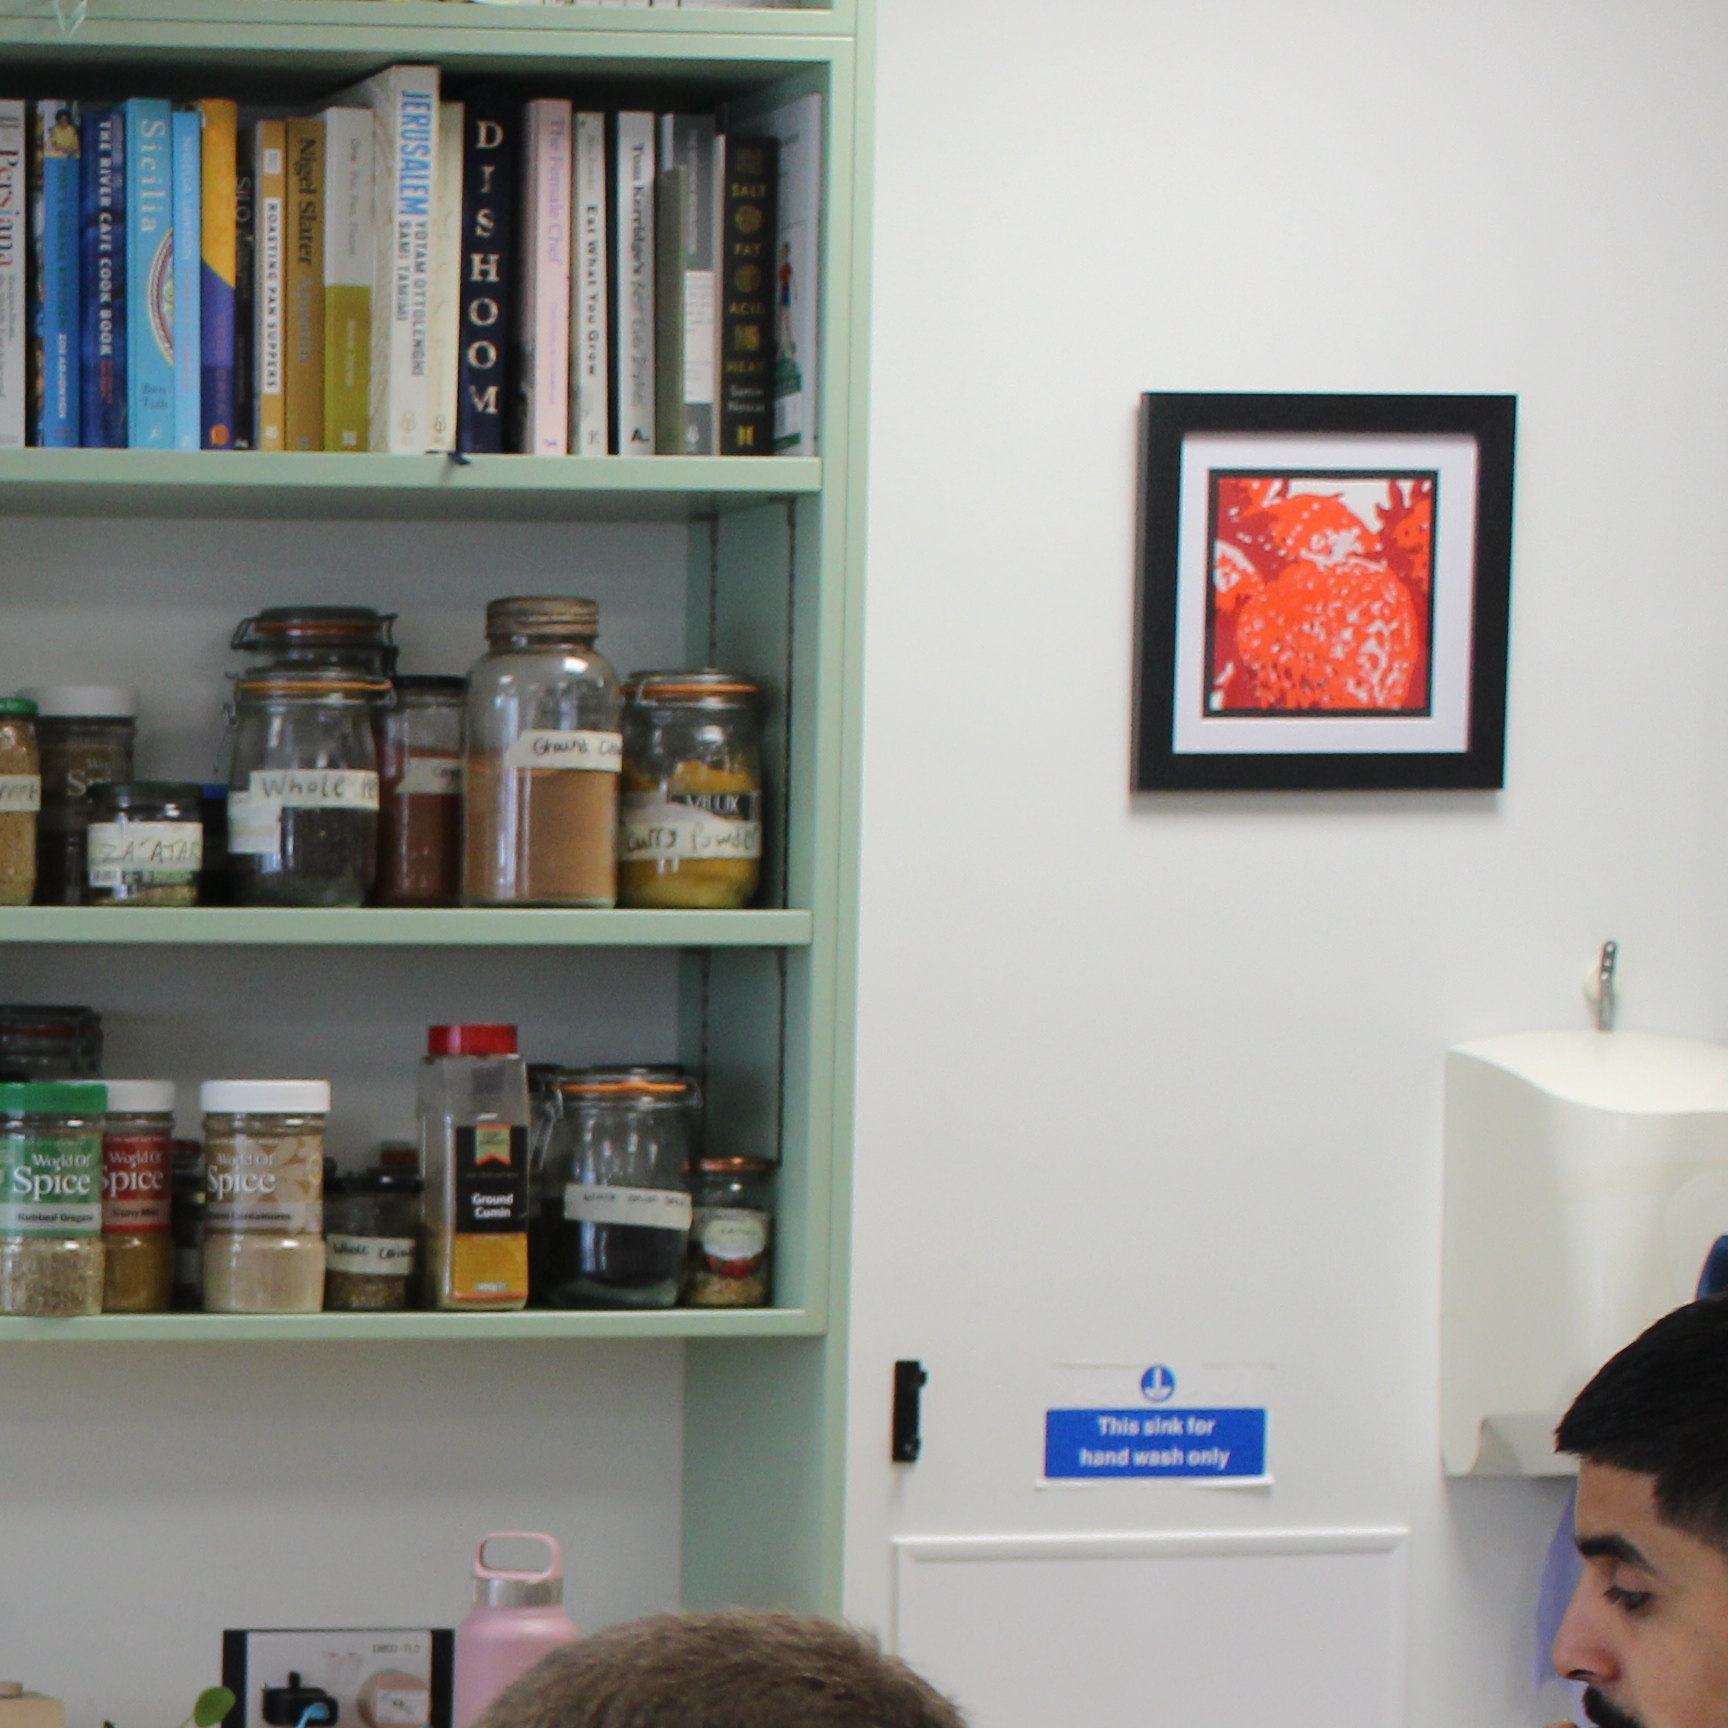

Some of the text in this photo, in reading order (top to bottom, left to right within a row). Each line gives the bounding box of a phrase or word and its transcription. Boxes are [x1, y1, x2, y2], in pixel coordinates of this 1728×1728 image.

[99, 120, 112, 151] THE
[399, 89, 433, 215] JERUSALEM
[140, 118, 167, 232] Sicilia
[295, 138, 317, 194] Nigel
[632, 142, 645, 181] Tom
[99, 157, 112, 207] RIVER
[548, 118, 565, 267] The Female Chef
[731, 181, 768, 199] SALT
[298, 200, 316, 267] Slater
[587, 205, 599, 234] Eat
[399, 220, 411, 260] SAMI
[733, 241, 762, 256] FAT
[99, 258, 111, 302] COOK
[467, 120, 504, 415] DISHOOM
[587, 240, 599, 286] What
[266, 202, 279, 389] ROASTING PAN SUPPERS
[412, 220, 427, 376] YOTAM OTTOLENGHI
[587, 293, 599, 325] You
[98, 309, 111, 356] BOOK
[587, 330, 599, 376] Grow
[262, 775, 344, 799] Whole
[32, 1154, 92, 1172] World Of
[109, 1151, 162, 1168] World Of
[217, 1152, 276, 1171] World Of
[12, 1167, 91, 1202] Spice
[207, 1166, 276, 1202] Spice
[472, 1192, 514, 1206] Ground
[17, 1212, 59, 1222] Rubbed
[474, 1206, 511, 1219] Cumin
[1097, 1416, 1216, 1436] This sink for
[1079, 1447, 1230, 1471] hand wash only
